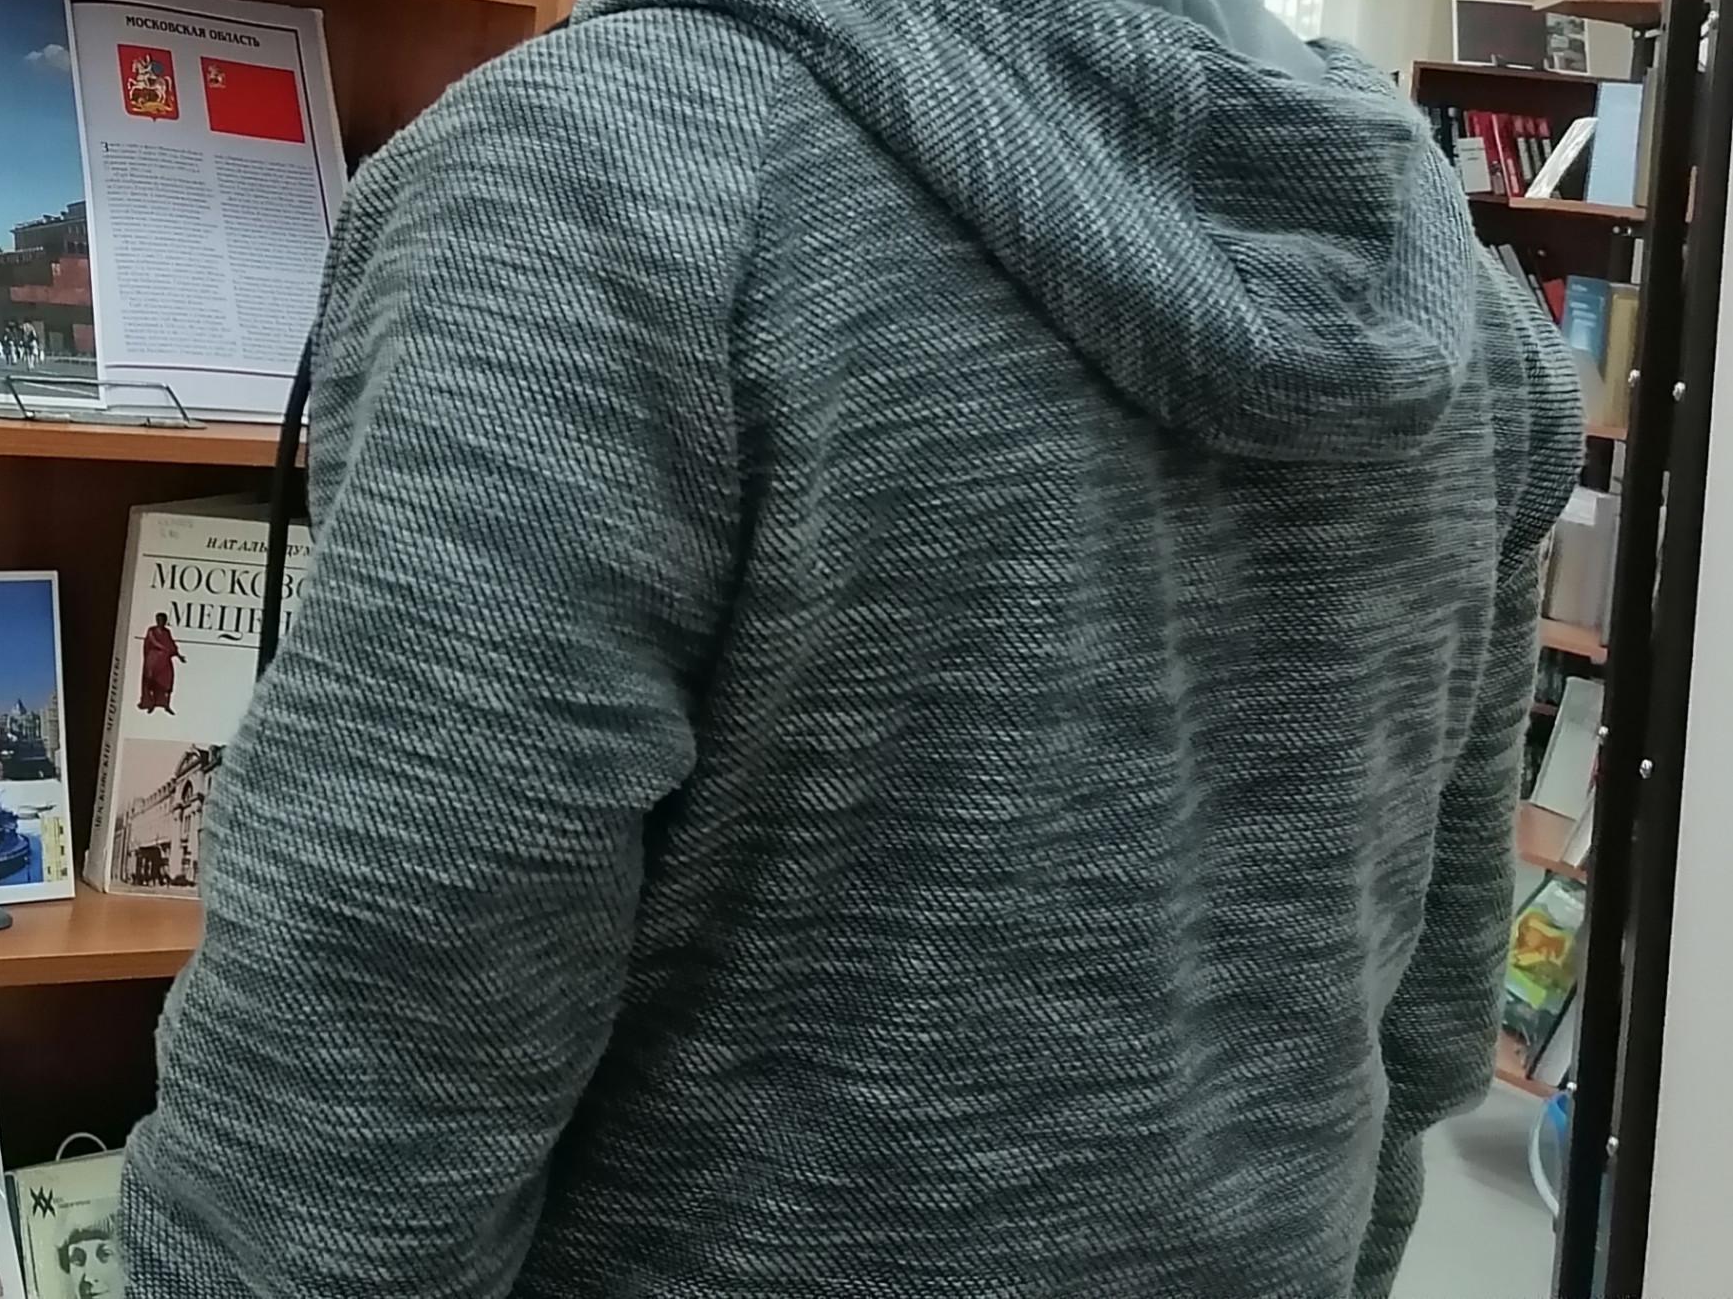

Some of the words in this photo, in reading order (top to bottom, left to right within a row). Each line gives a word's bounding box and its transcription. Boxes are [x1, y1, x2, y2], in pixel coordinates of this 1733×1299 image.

[126, 15, 207, 39] МОСКОВСКАЯ
[209, 28, 260, 48] ОБЛАСТЬ
[206, 537, 269, 553] НАТАЛЬ
